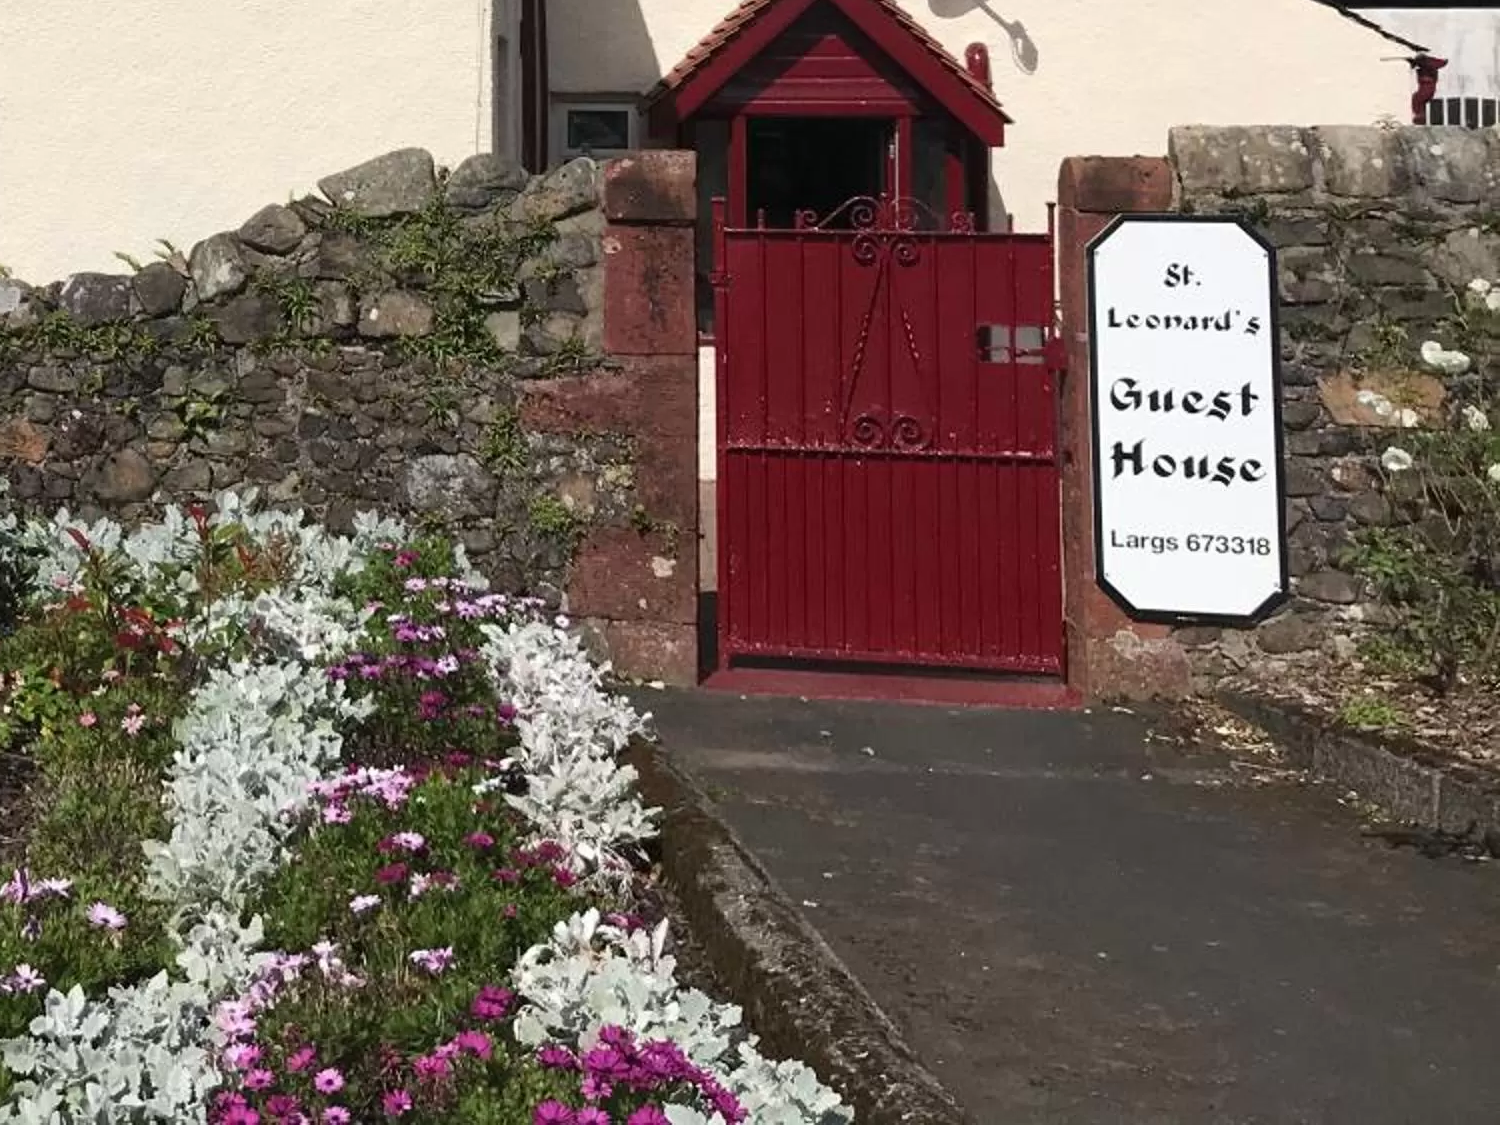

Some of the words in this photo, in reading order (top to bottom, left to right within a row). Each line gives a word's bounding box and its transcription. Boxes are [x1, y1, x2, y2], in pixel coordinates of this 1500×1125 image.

[1163, 263, 1202, 288] St.
[1107, 307, 1261, 335] Leonard's
[1109, 377, 1260, 422] Guest
[1110, 438, 1267, 487] House
[1111, 530, 1179, 554] Largs
[1186, 534, 1271, 556] 673318
